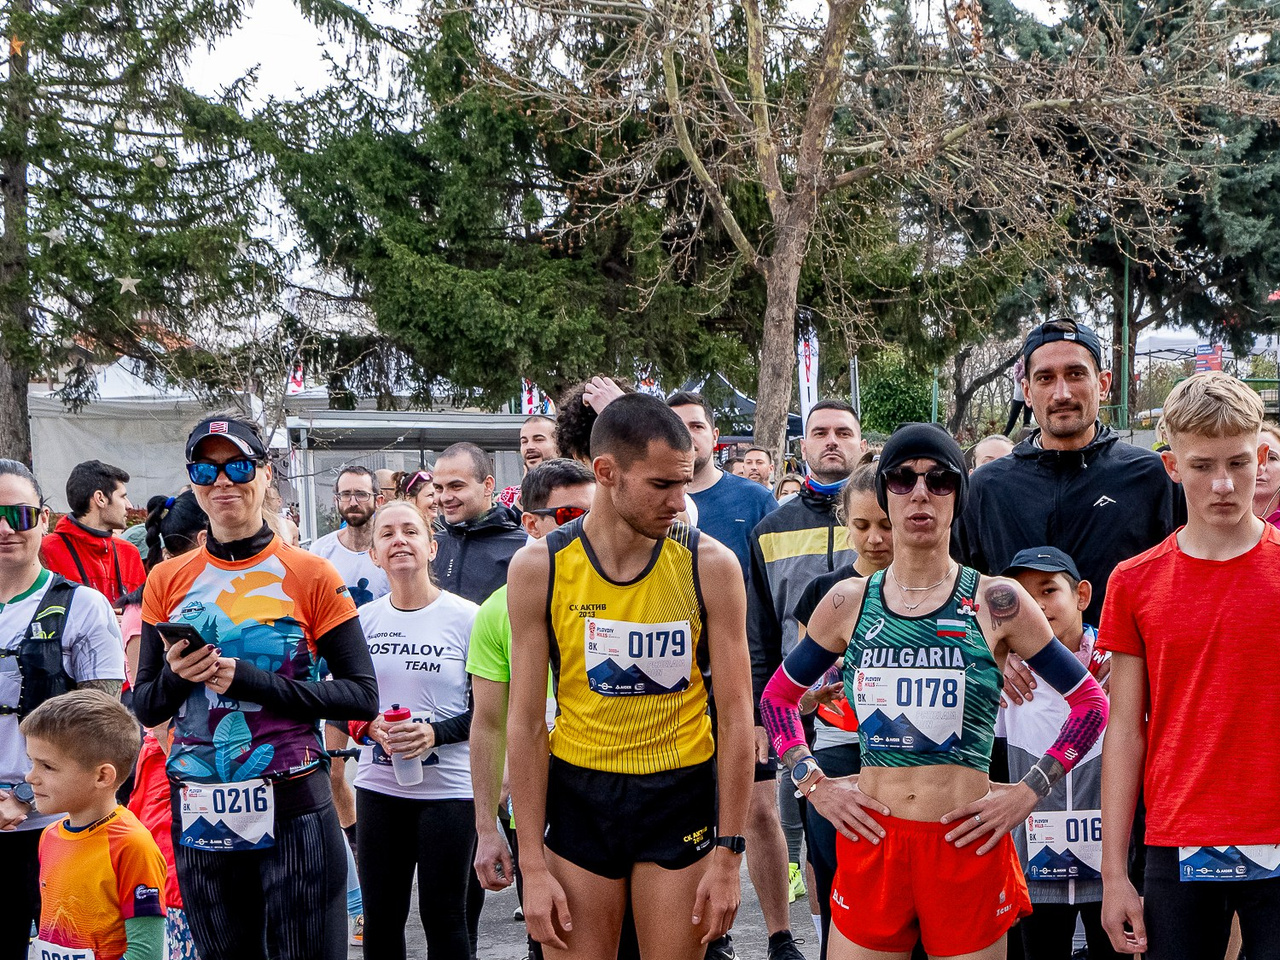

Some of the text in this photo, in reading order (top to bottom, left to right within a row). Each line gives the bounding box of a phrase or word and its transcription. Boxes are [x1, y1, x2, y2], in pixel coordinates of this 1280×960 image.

[580, 603, 607, 611] АКТИВ
[588, 642, 598, 651] 8K
[628, 629, 685, 658] 0179
[405, 660, 441, 673] TEAM
[860, 647, 965, 668] BULGARIA
[857, 693, 866, 702] 8K
[896, 677, 958, 708] 0178
[212, 786, 268, 814] 0216
[1066, 817, 1102, 842] 016
[832, 888, 850, 910] BUL
